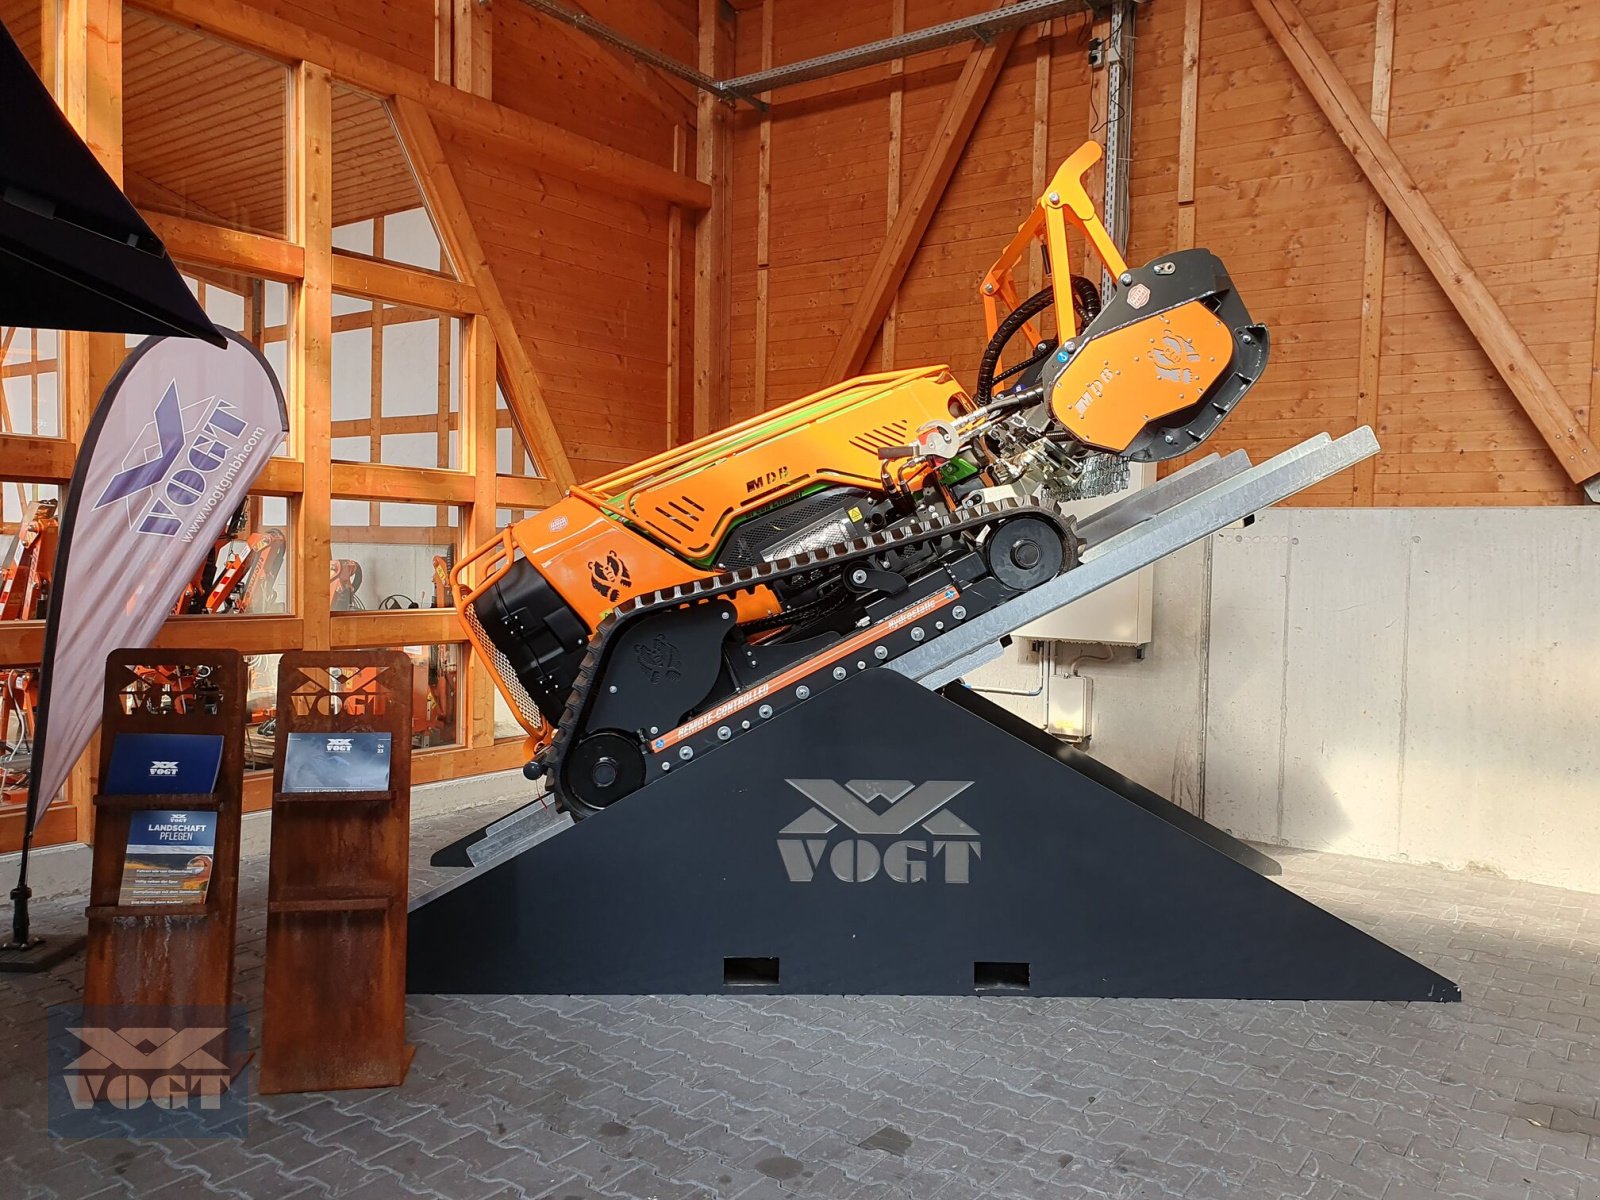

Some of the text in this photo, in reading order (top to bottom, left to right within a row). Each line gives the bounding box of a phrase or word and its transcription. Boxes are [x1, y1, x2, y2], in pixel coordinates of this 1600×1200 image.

[136, 399, 248, 537] VOGT
[181, 427, 265, 544] www.vogtgmbh.com
[888, 600, 936, 629] Hydrostatic
[290, 694, 390, 715] VOGT
[148, 824, 207, 832] LANDSCHAFT
[159, 832, 193, 841] PFLEGEN
[776, 839, 982, 884] VOGT
